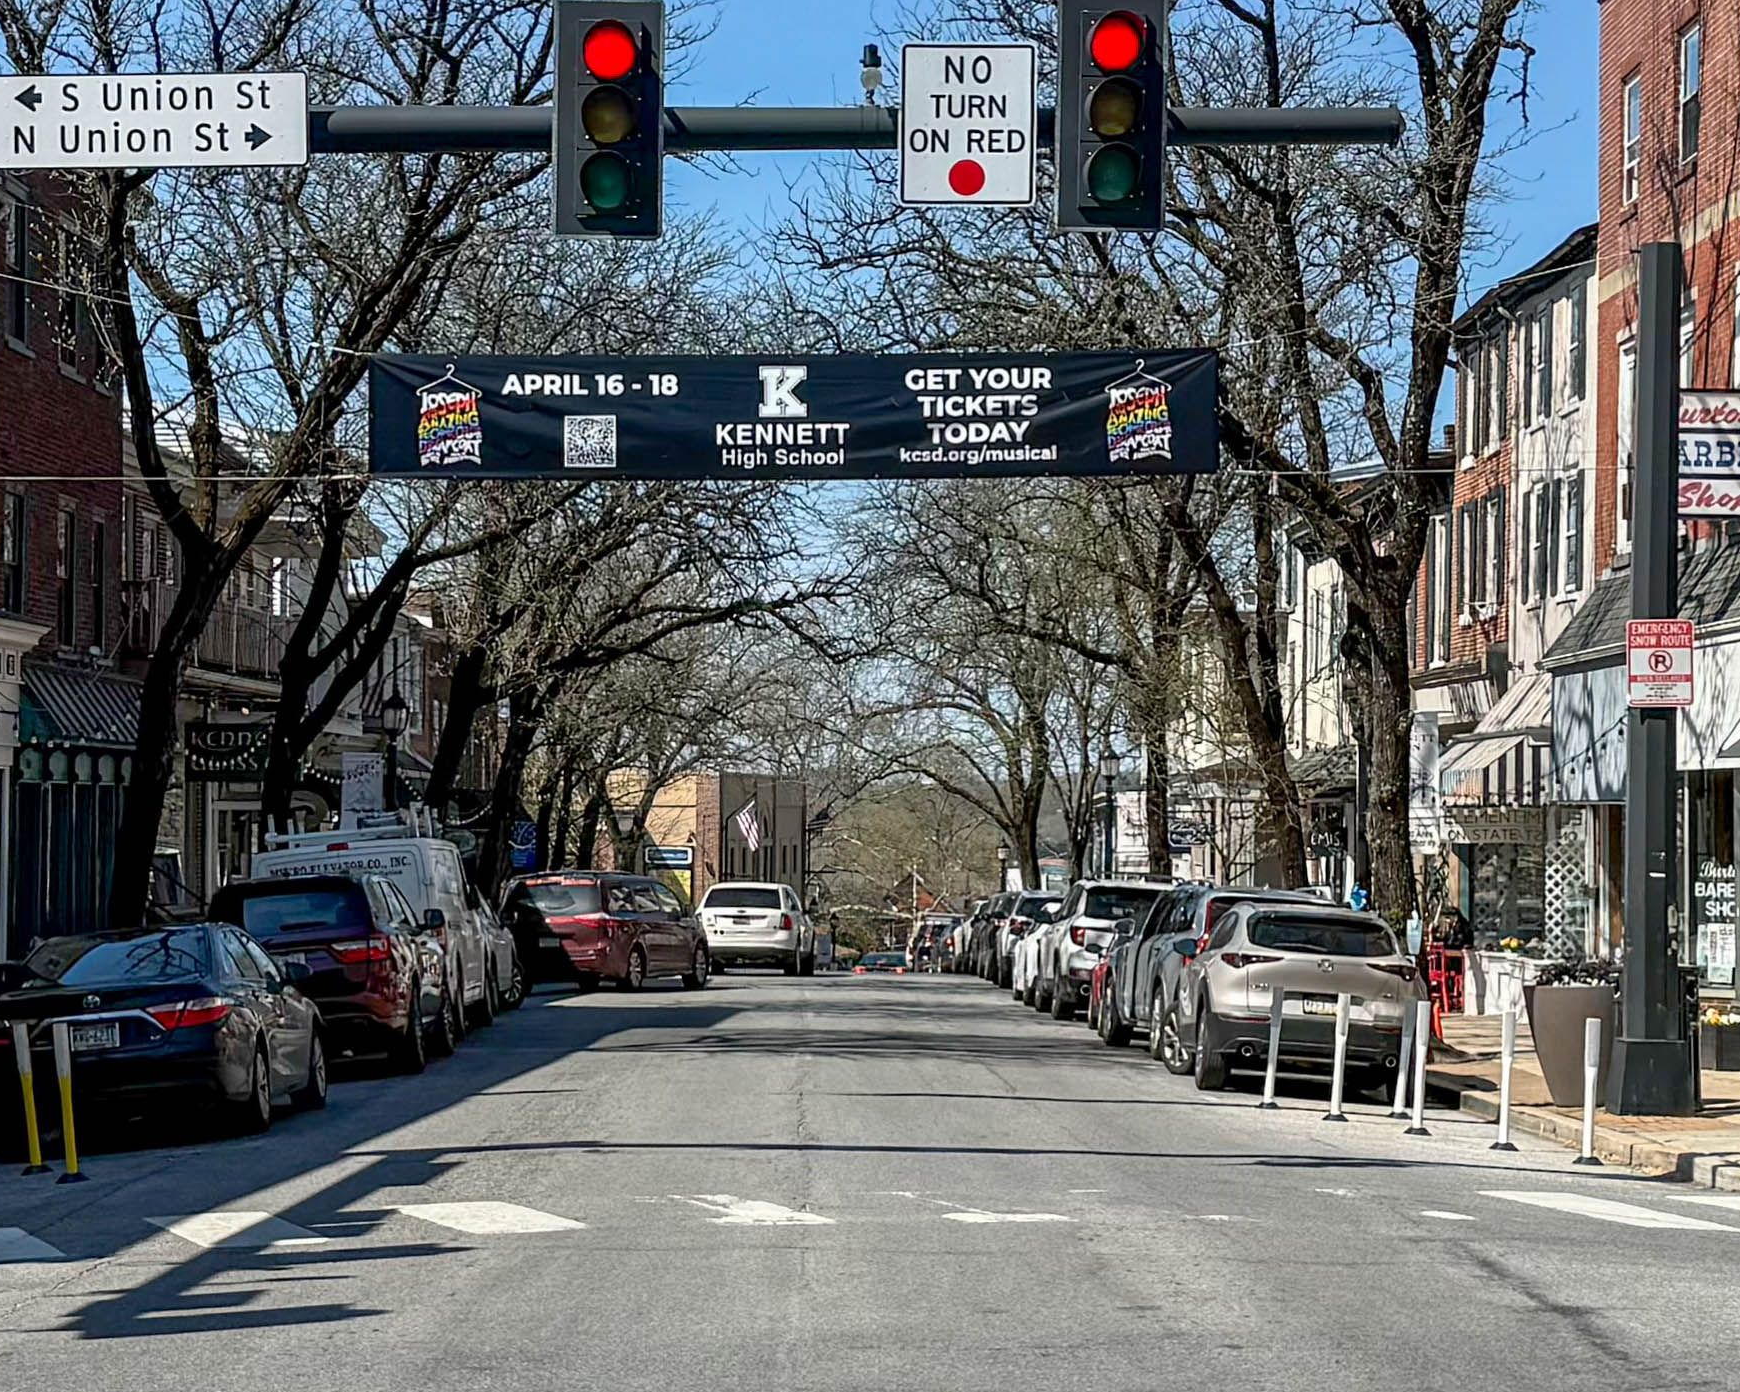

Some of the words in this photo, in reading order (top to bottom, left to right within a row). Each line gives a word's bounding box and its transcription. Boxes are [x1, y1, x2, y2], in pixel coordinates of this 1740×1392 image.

[945, 55, 992, 84] NO
[62, 83, 79, 112] S
[102, 79, 213, 111] Union
[236, 80, 271, 109] St
[930, 94, 1007, 119] TURN
[14, 125, 36, 154] N
[59, 121, 172, 153] Union
[195, 121, 230, 152] St
[909, 128, 950, 154] ON
[966, 129, 1026, 154] RED
[500, 374, 589, 396] APRIL
[594, 374, 625, 396] 16
[648, 374, 679, 396] 18
[904, 369, 962, 391] GET
[968, 367, 1053, 390] YOUR
[916, 395, 1039, 418] TICKETS
[716, 424, 850, 446] KENNETT
[927, 422, 1030, 445] TODAY
[722, 449, 768, 470] High
[775, 449, 845, 466] School
[899, 445, 1058, 464] kcsd.org/musical
[1632, 622, 1689, 634] EMERGENCY
[1631, 635, 1657, 647] SNOW
[1660, 635, 1692, 646] ROUTE
[1471, 828, 1517, 841] STATE
